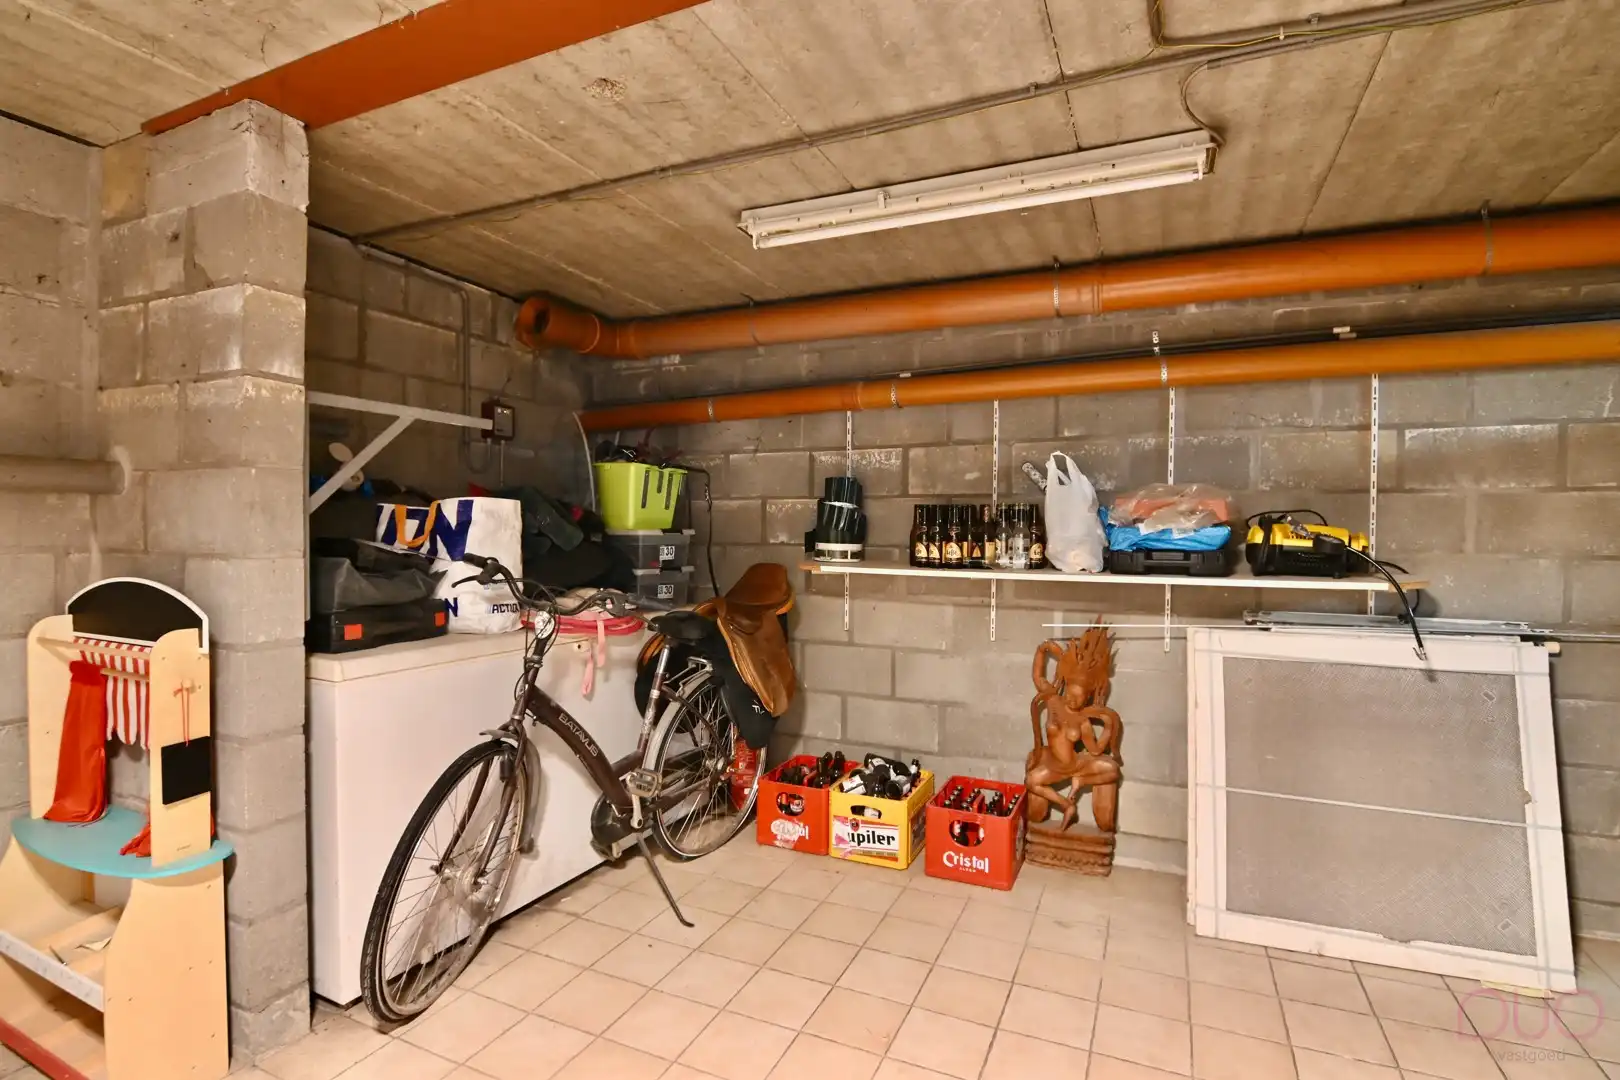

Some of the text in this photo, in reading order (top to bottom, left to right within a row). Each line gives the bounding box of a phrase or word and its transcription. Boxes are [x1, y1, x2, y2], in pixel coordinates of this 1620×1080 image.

[491, 603, 520, 614] ACTIO
[559, 713, 599, 757] BATAVUS
[847, 830, 896, 847] upiler
[943, 850, 989, 873] Cristal
